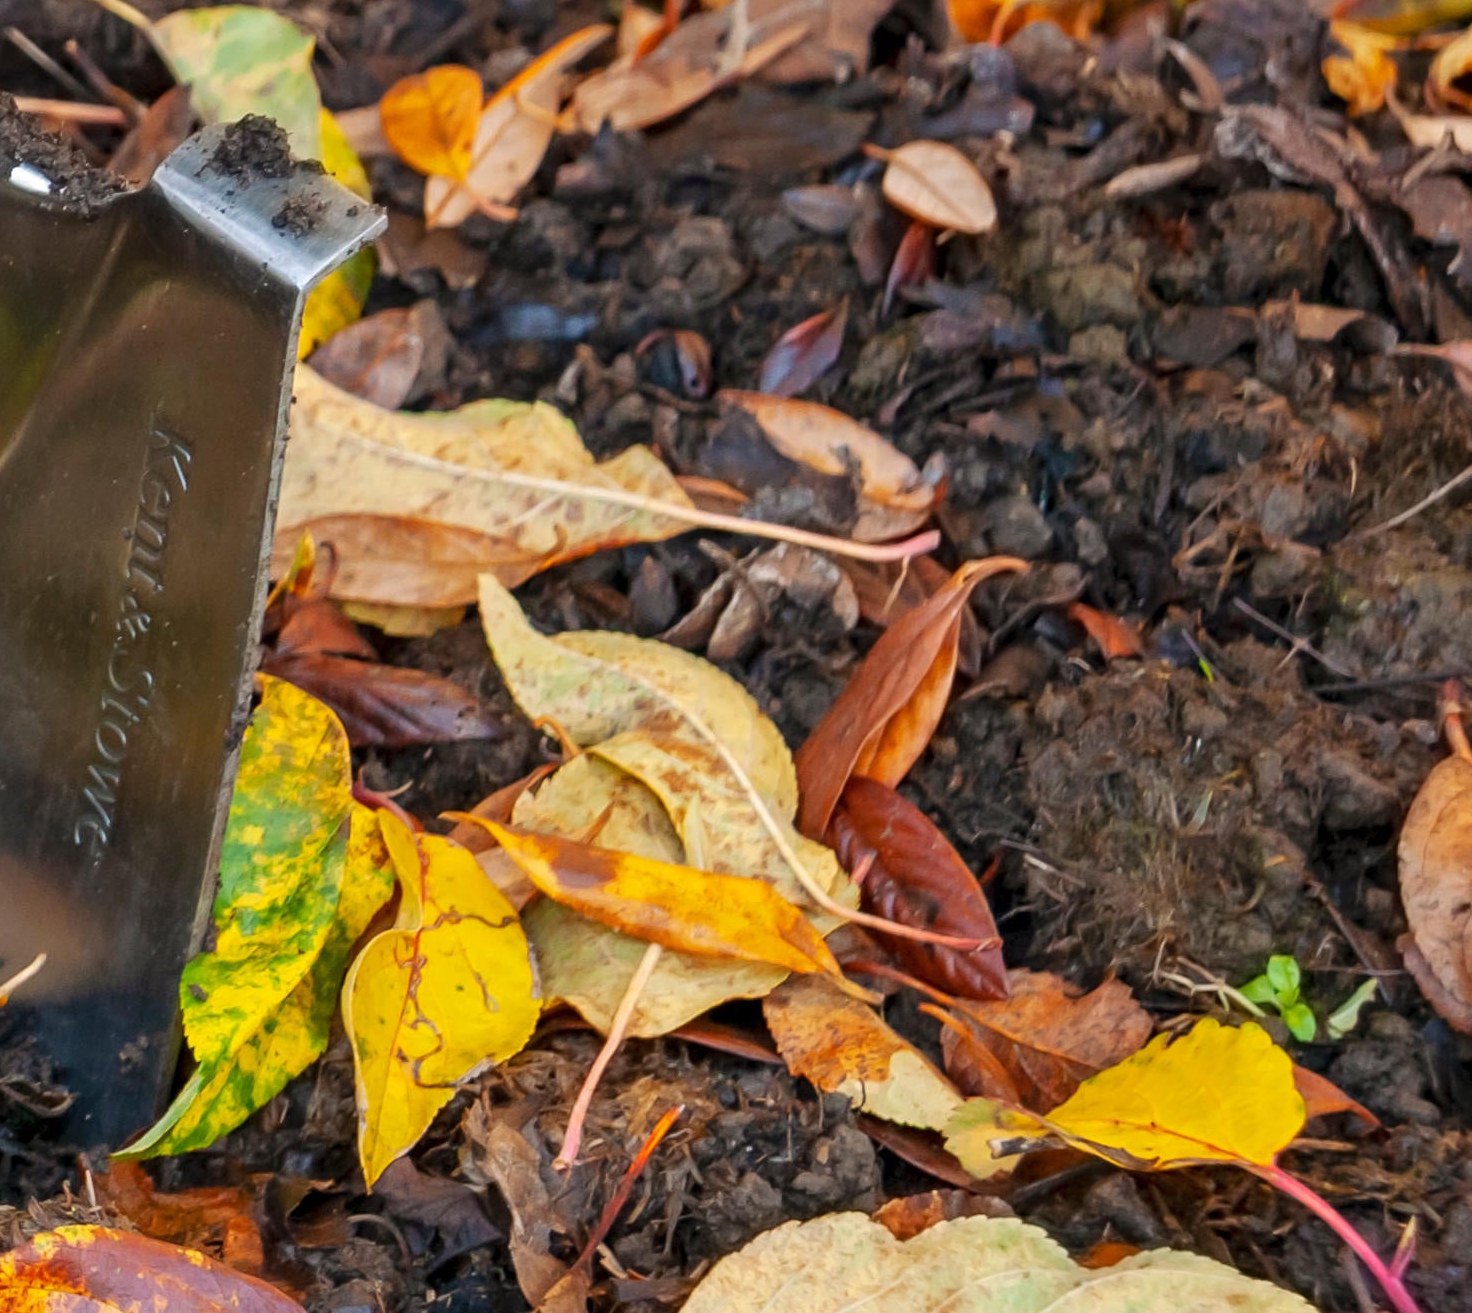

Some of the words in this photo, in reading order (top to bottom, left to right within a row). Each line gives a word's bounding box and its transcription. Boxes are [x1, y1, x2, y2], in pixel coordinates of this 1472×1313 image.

[125, 422, 194, 593] Kent
[116, 593, 153, 641] &
[74, 647, 154, 868] Stowe
